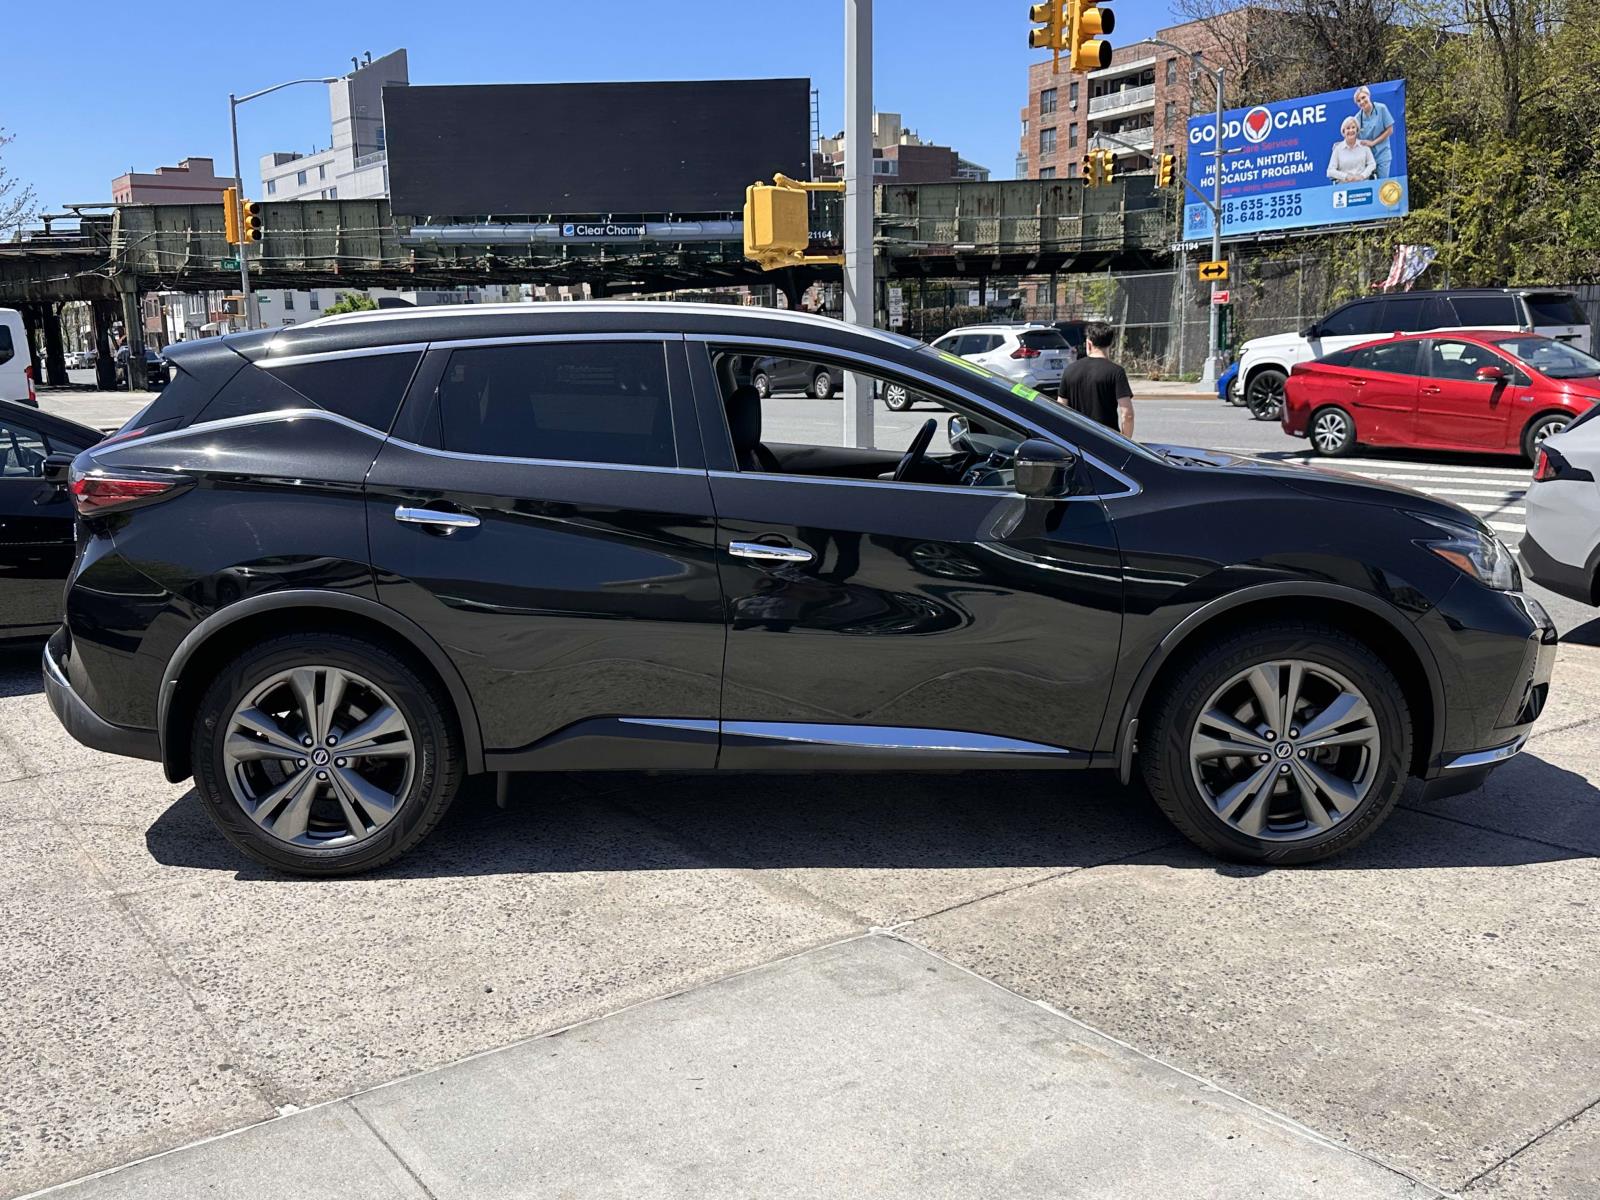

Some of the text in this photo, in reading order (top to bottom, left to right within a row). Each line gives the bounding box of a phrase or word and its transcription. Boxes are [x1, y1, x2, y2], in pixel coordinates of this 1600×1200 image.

[1274, 104, 1327, 129] CARE
[1231, 159, 1254, 171] PCA,
[1257, 151, 1308, 167] NHTD/TBI,
[1200, 162, 1314, 187] HOOCAUST PROGRAM
[1222, 193, 1302, 213] 18-635-3535
[1222, 205, 1302, 225] 18-648-2020
[576, 225, 605, 235] Clear
[808, 231, 832, 239] 21164
[1171, 242, 1198, 251] 921194
